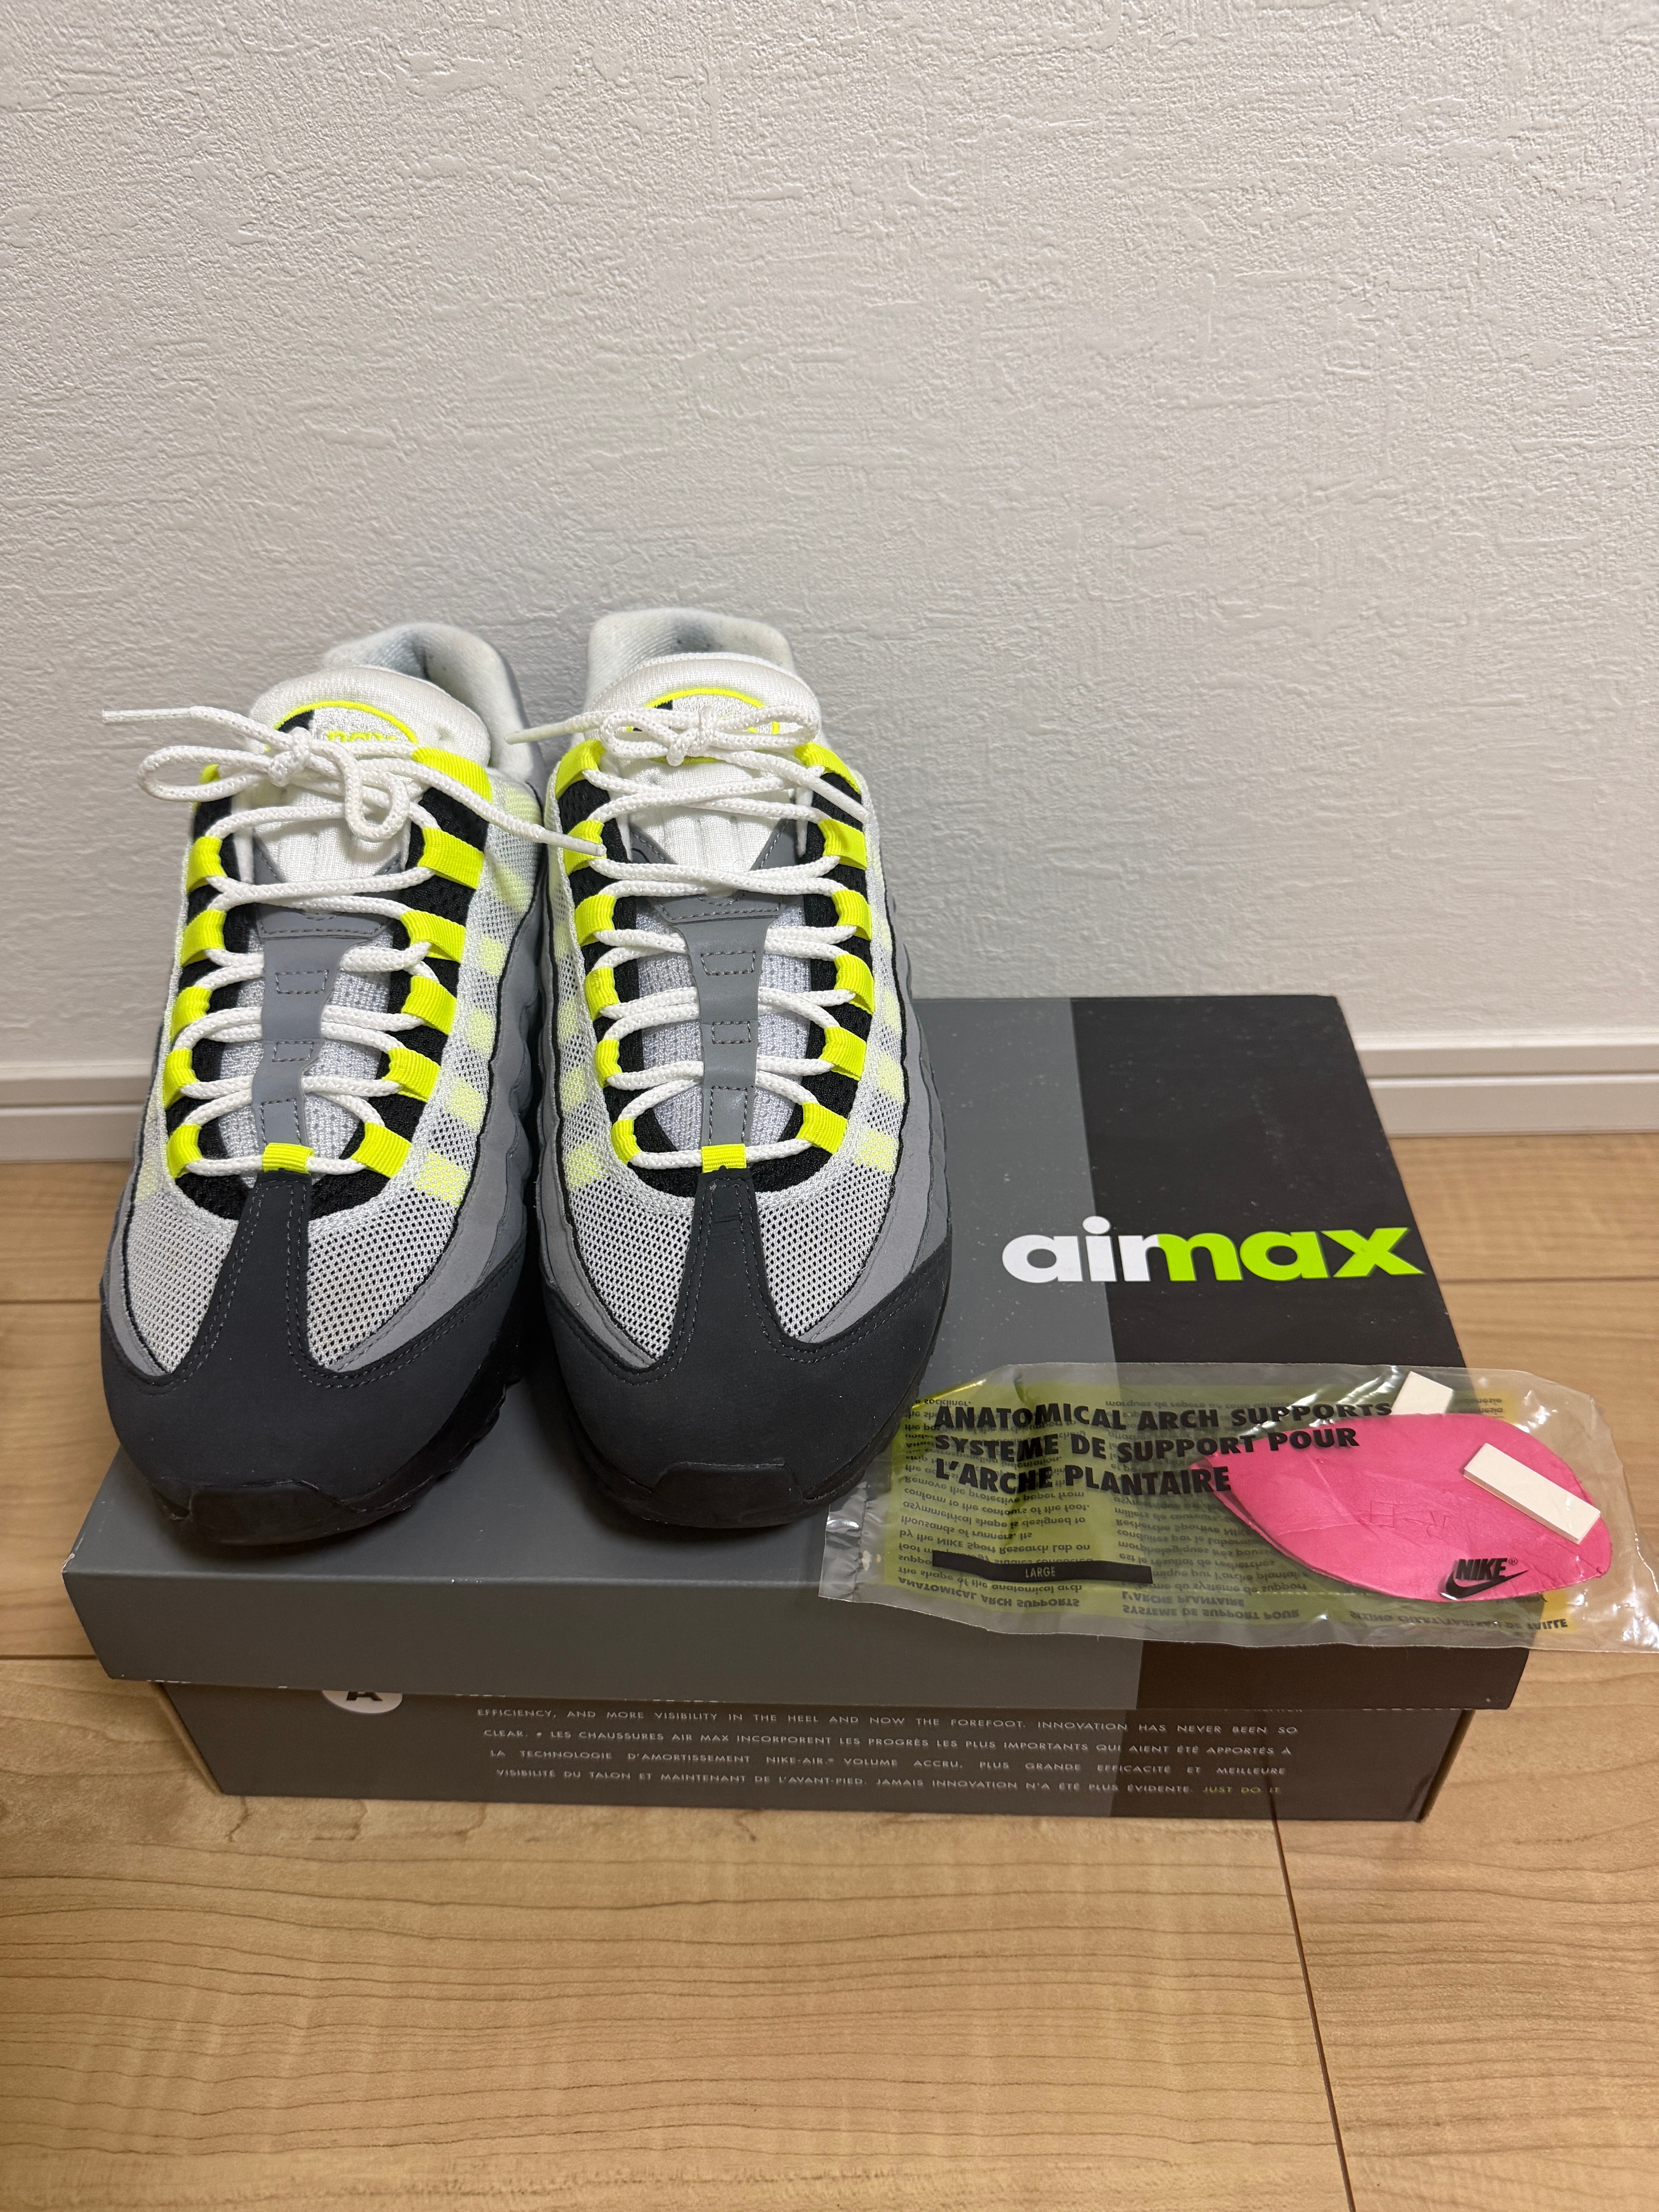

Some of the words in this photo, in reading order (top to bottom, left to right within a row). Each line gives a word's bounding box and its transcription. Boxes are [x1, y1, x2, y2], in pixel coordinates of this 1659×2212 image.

[1002, 1216, 1425, 1283] airmax
[934, 1402, 1126, 1431] ANATOMICAL
[1137, 1409, 1218, 1431] ARCH
[1231, 1403, 1392, 1427] SUPPORTS
[935, 1434, 1059, 1462] SYSTEME
[1070, 1434, 1107, 1459] DE
[1117, 1434, 1256, 1463] SUPPORT
[1268, 1427, 1359, 1451] POUR
[935, 1458, 1053, 1494] L'ARCHE
[1065, 1464, 1231, 1495] PLANTAIRE
[1025, 1567, 1055, 1578] LARGE
[1455, 1558, 1507, 1580] NIKE
[477, 1709, 556, 1718] EFFICIENCY,
[567, 1710, 596, 1718] AND
[606, 1711, 644, 1719] MORE
[654, 1712, 718, 1721] VISIBILITY
[788, 1715, 819, 1723] HEEL
[829, 1716, 859, 1724] AND
[916, 1718, 939, 1726] THE
[951, 1719, 1026, 1728] FOREFOOT.
[1037, 1721, 1127, 1732] INNOVATION
[1139, 1724, 1166, 1732] HAS
[1177, 1725, 1221, 1733] NEVER
[1232, 1726, 1267, 1734] BEEN
[579, 1731, 664, 1741] CHAUSSURES
[737, 1735, 831, 1745] INCORPORENT
[840, 1738, 860, 1746] LES
[868, 1738, 929, 1748] PROGRÈS
[936, 1740, 957, 1748] LES
[965, 1741, 996, 1749] PLUS
[1004, 1741, 1088, 1751] IMPORTANTS
[1096, 1744, 1121, 1753] QUI
[1128, 1745, 1169, 1754] AIENT
[1176, 1745, 1199, 1754] ÉTÉ
[1206, 1746, 1274, 1756] APPORTÉS
[490, 1750, 505, 1758] LA
[520, 1750, 612, 1760] TECHNOLOGIE
[844, 1757, 898, 1766] VOLUME
[979, 1761, 1009, 1769] PLUS
[1025, 1762, 1081, 1772] GRANDE
[1187, 1765, 1201, 1774] ET
[1216, 1767, 1285, 1775] MEILLEURE
[564, 1770, 581, 1778] DU
[589, 1771, 631, 1780] TALON
[639, 1772, 652, 1780] ET
[661, 1773, 746, 1783] MAINTENANT
[876, 1778, 924, 1787] JAMAIS
[933, 1779, 1018, 1790] INNOVATION
[1089, 1783, 1119, 1791] PLUS
